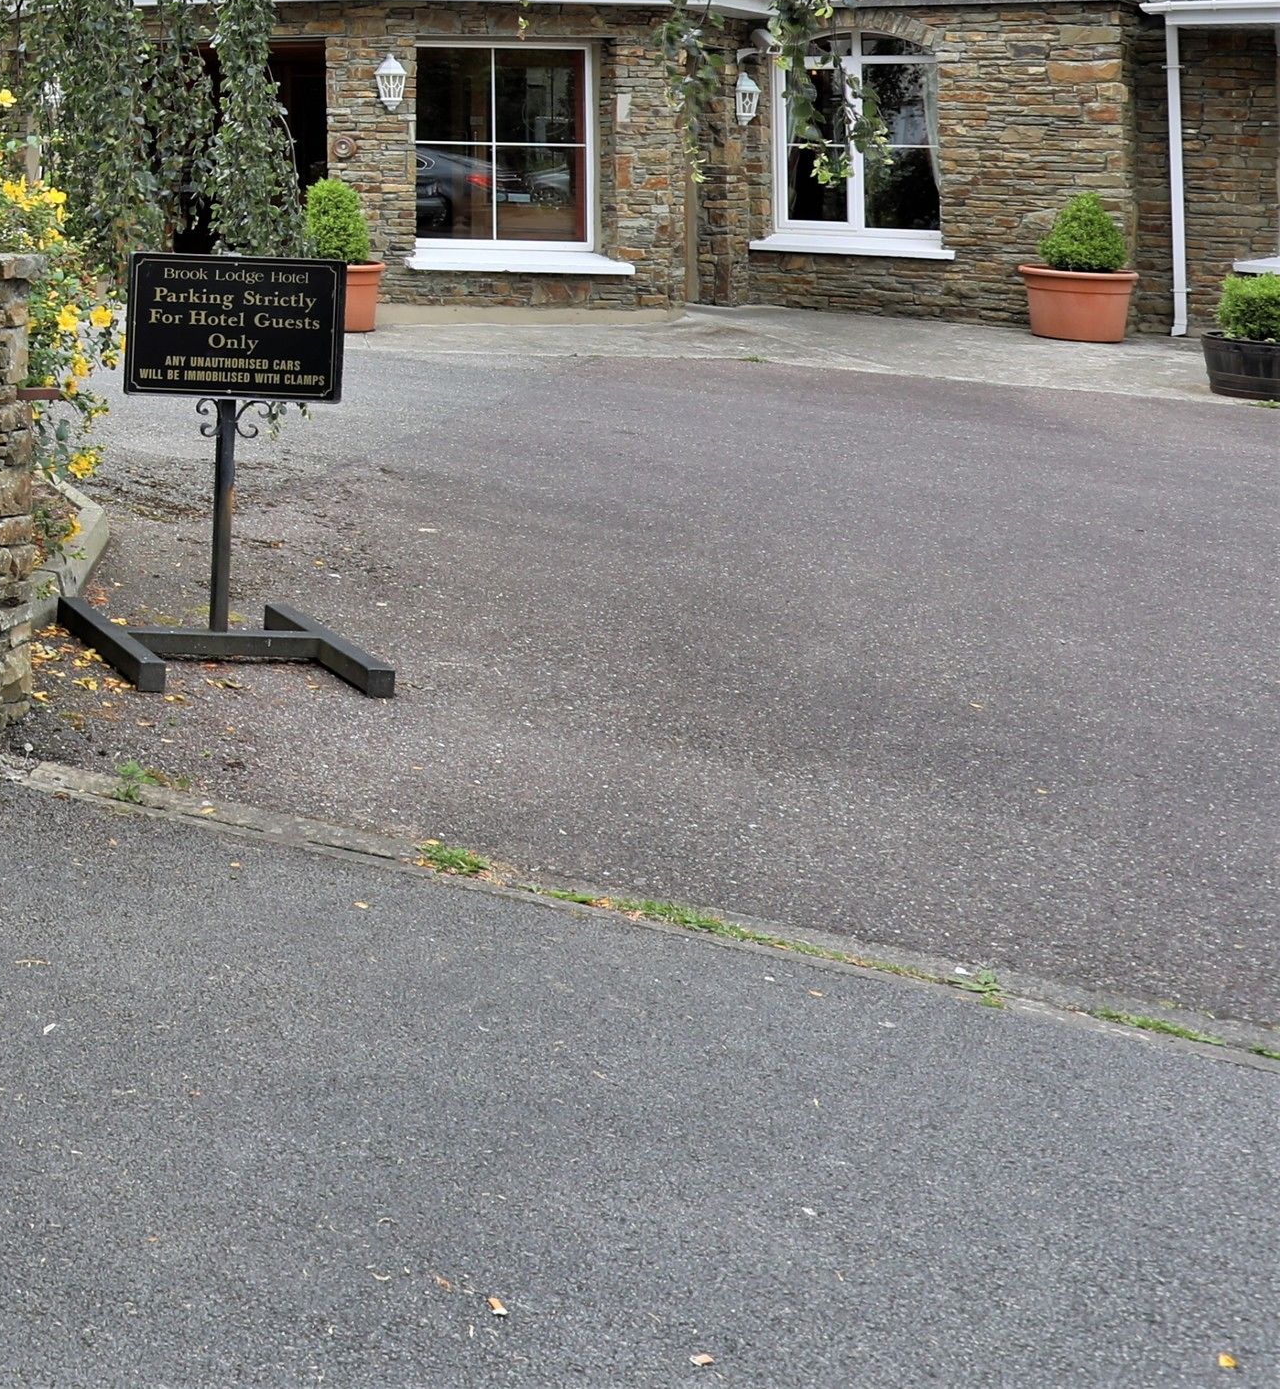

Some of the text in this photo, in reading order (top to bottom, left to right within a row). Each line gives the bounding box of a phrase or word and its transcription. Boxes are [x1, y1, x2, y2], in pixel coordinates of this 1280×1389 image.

[165, 268, 308, 283] Brook Lodge Hotel
[155, 288, 316, 312] Parking Strictly
[150, 309, 319, 329] For Hotel Guests
[209, 334, 258, 354] Only
[166, 356, 300, 370] ANY UNAUTHORISED CARS
[140, 369, 324, 385] WILL BE IMMOBILISED WITH CLAMPS
